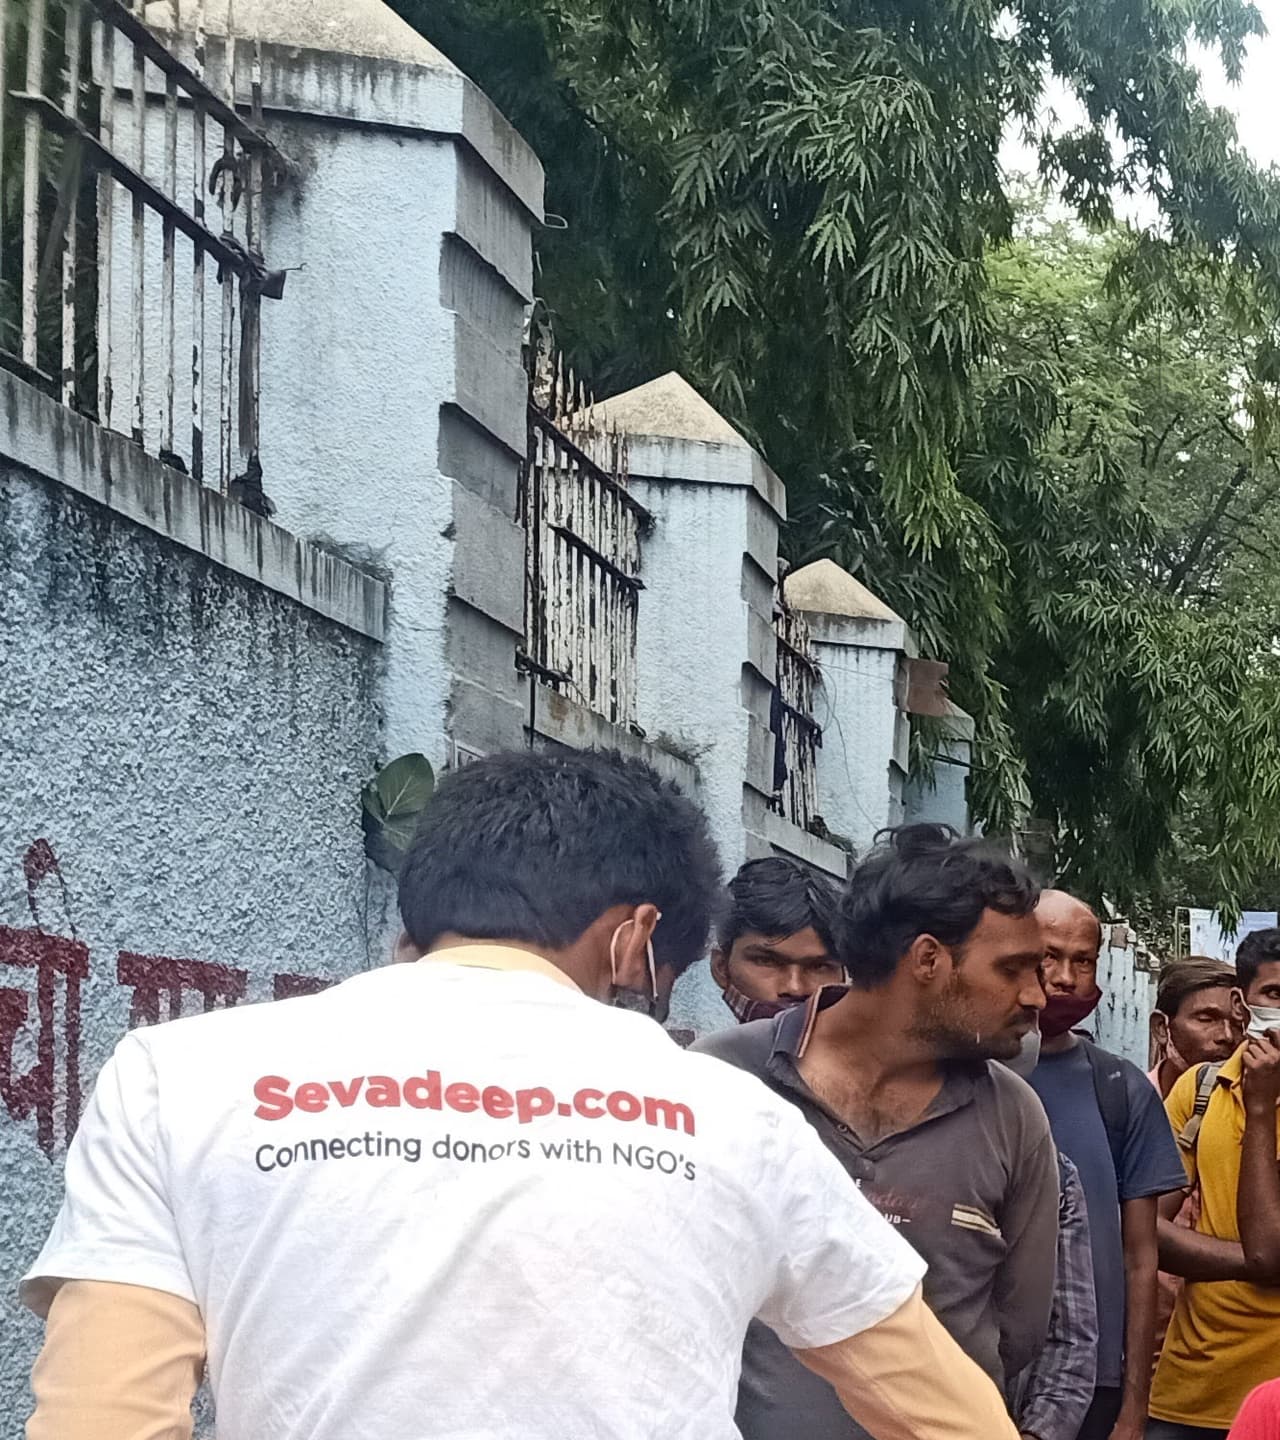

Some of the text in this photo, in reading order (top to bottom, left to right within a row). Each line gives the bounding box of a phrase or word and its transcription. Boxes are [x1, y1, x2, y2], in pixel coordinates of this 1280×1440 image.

[253, 1070, 695, 1136] Sevadeep.com
[255, 1132, 696, 1180] Connecting donors with NGO's
